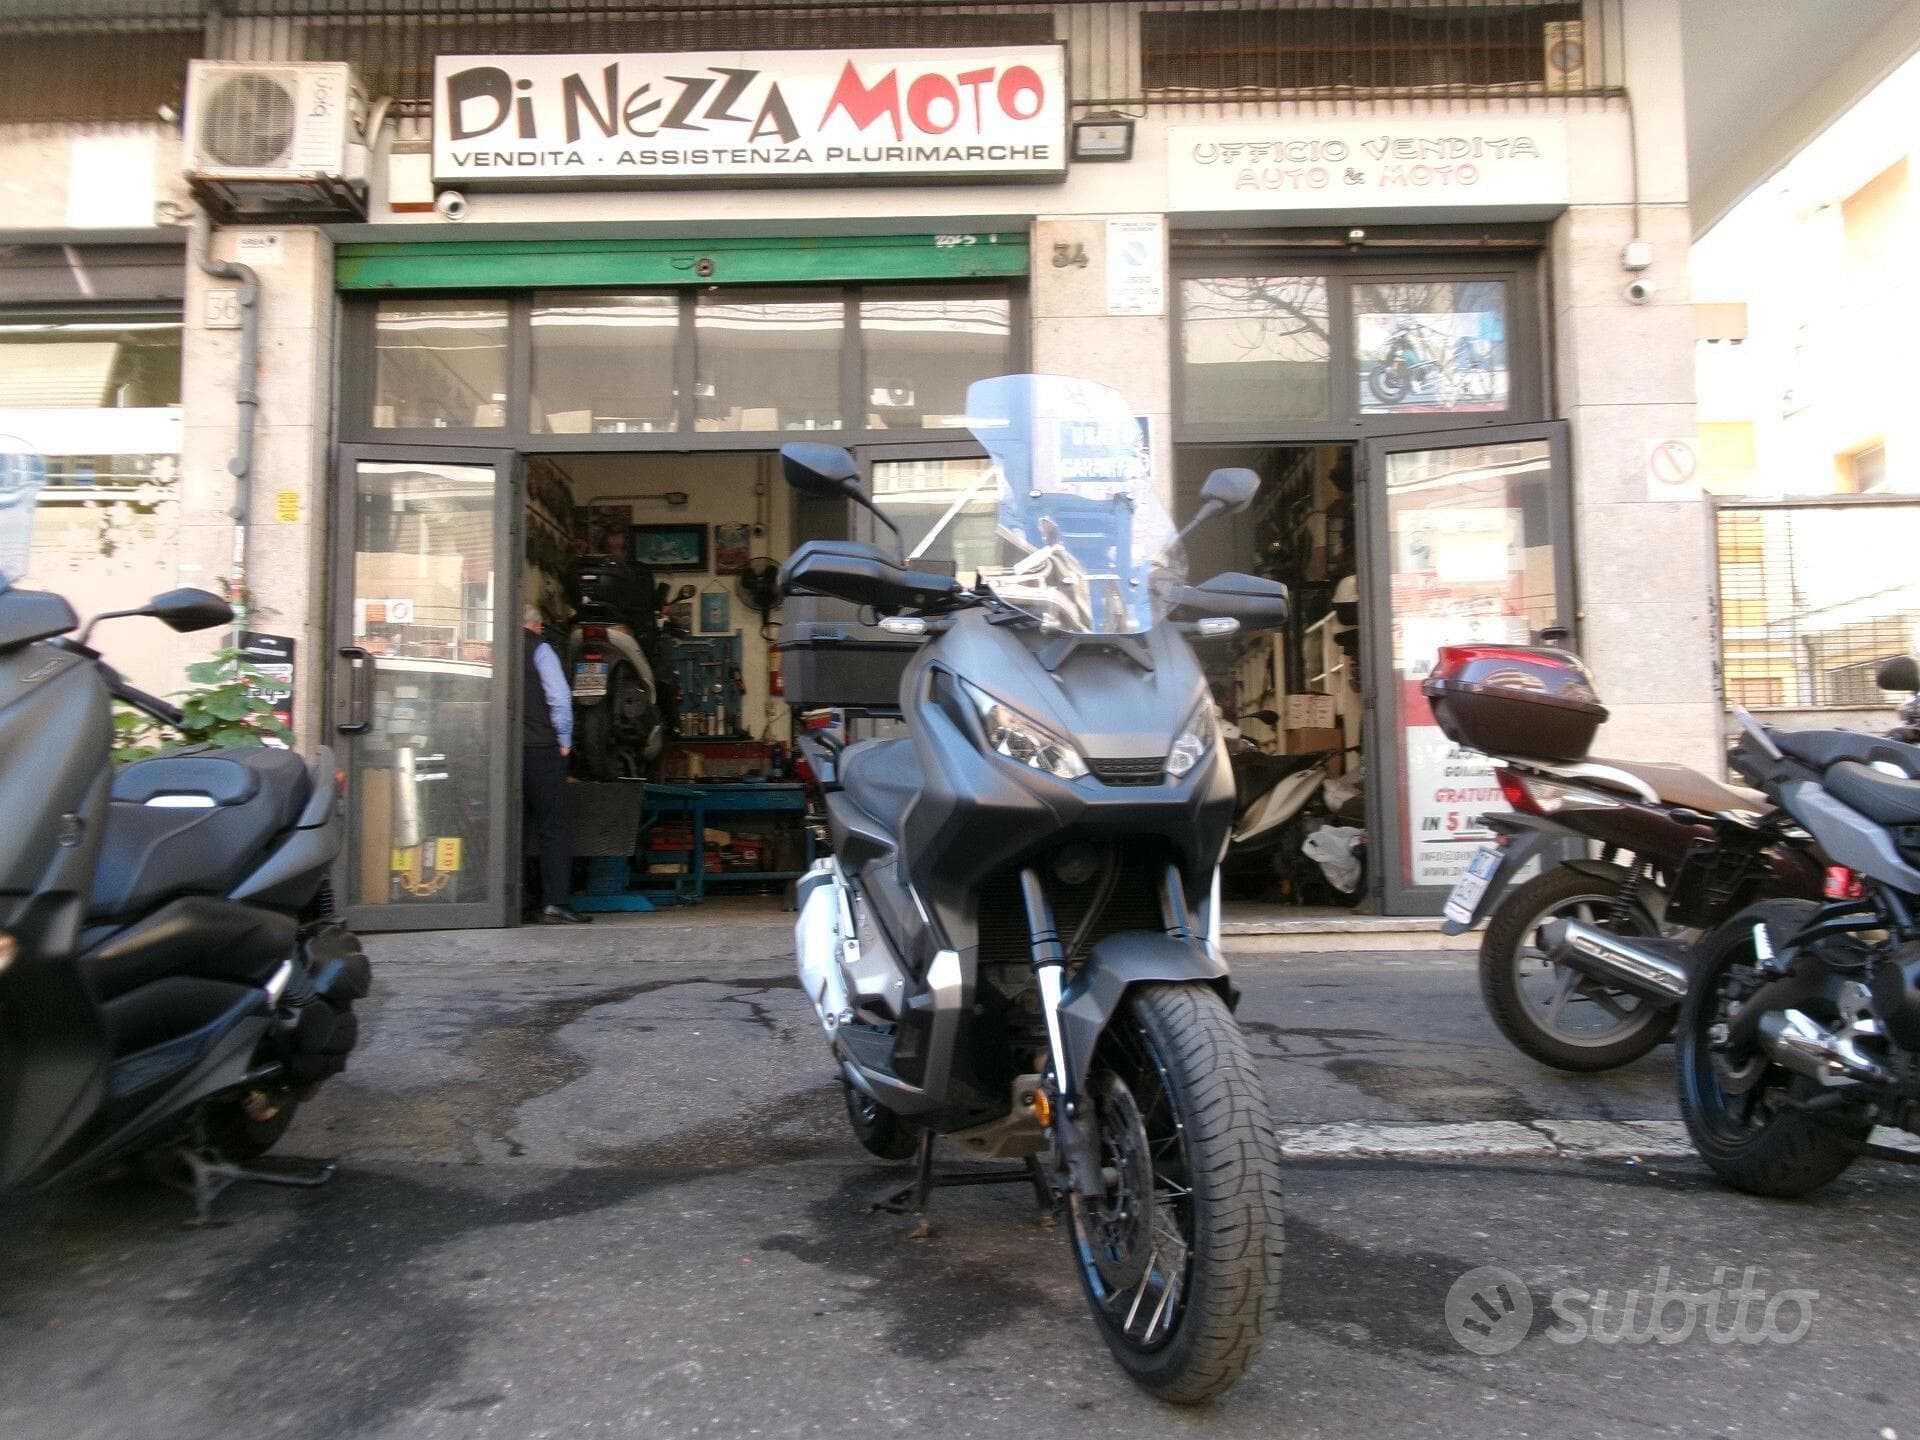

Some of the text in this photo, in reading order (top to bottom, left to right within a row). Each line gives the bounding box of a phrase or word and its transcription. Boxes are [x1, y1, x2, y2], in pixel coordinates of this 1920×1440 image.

[817, 59, 1045, 142] MOTO
[451, 150, 585, 167] VENDITA
[616, 146, 815, 166] ASSISTENZA
[826, 144, 1050, 163] PLURIMARCHE
[1193, 135, 1540, 164] UFFICIO VENDITA
[1235, 163, 1481, 190] AUTO & MOTO
[1052, 241, 1089, 268] 34
[1421, 817, 1441, 831] IN
[1446, 811, 1459, 831] 5
